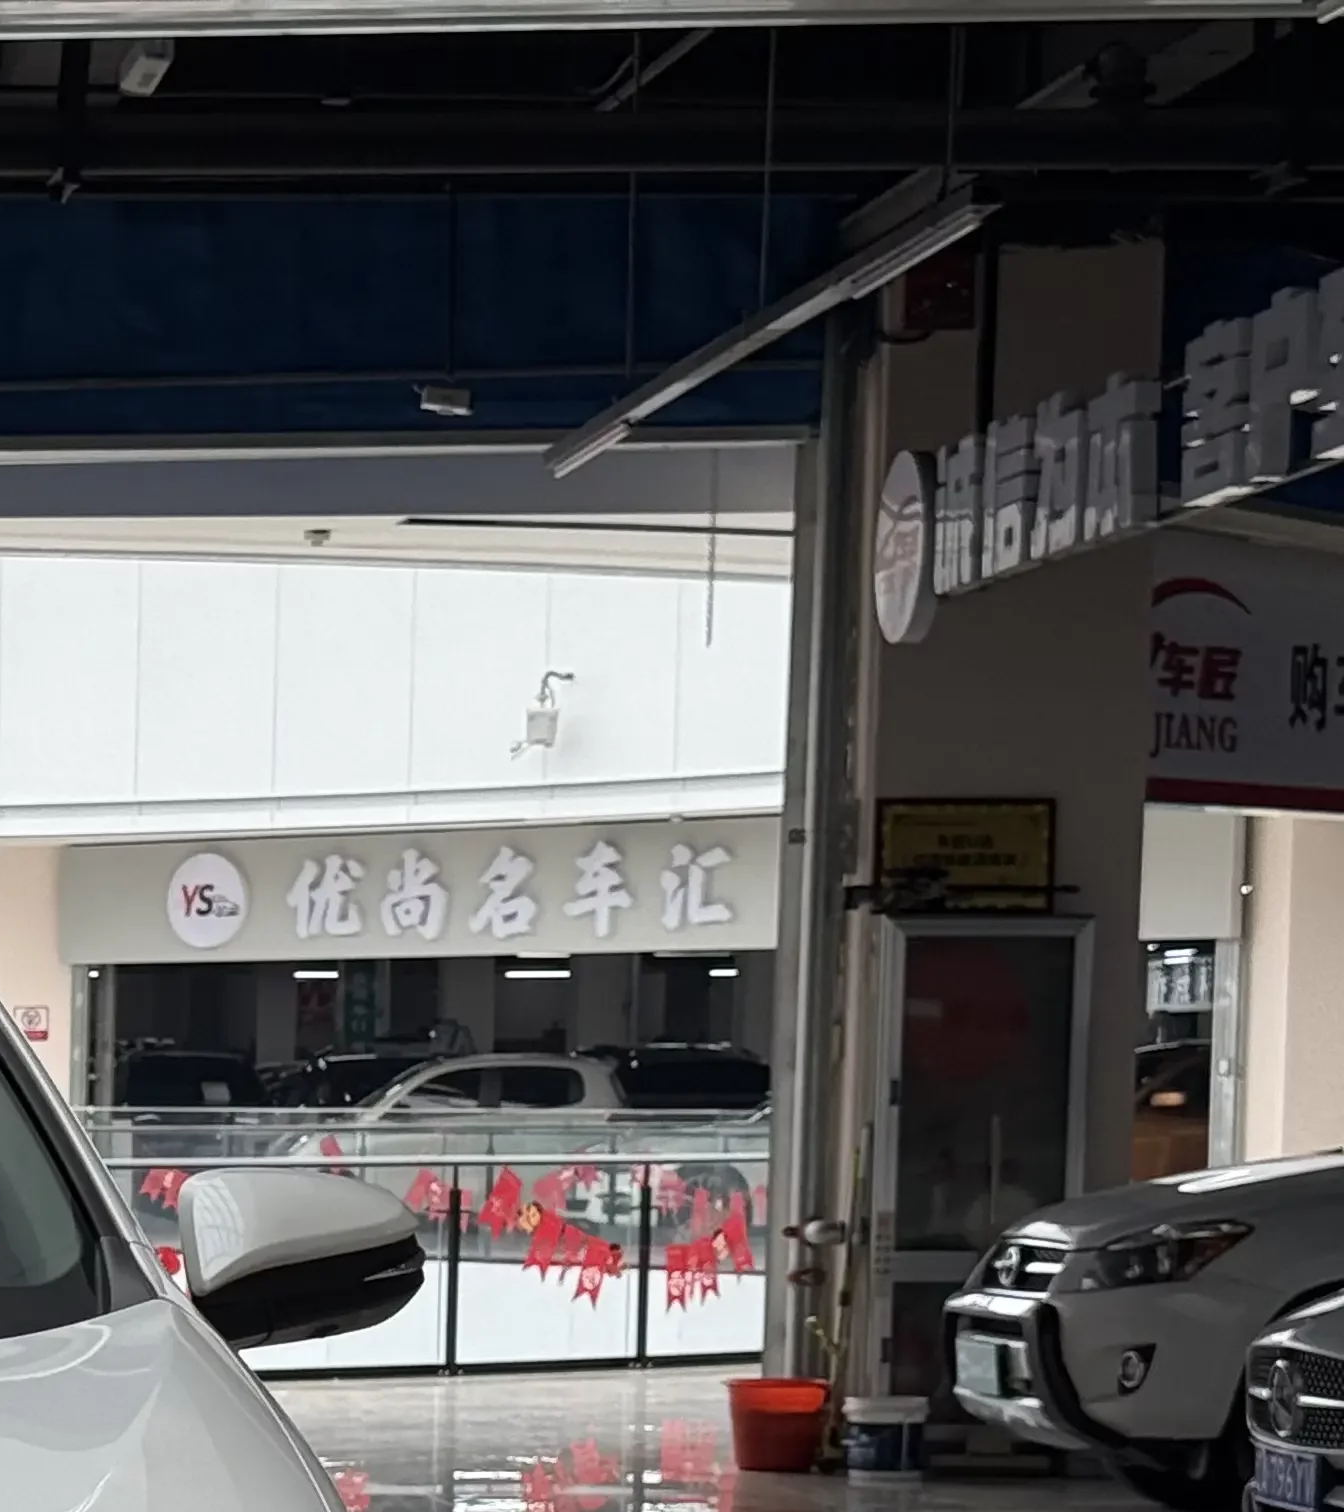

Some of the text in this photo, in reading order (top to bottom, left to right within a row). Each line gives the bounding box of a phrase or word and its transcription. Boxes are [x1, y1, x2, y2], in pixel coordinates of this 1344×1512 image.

[1288, 643, 1344, 732] 购
[181, 883, 214, 918] YS
[287, 841, 733, 939] 优尚名车汇
